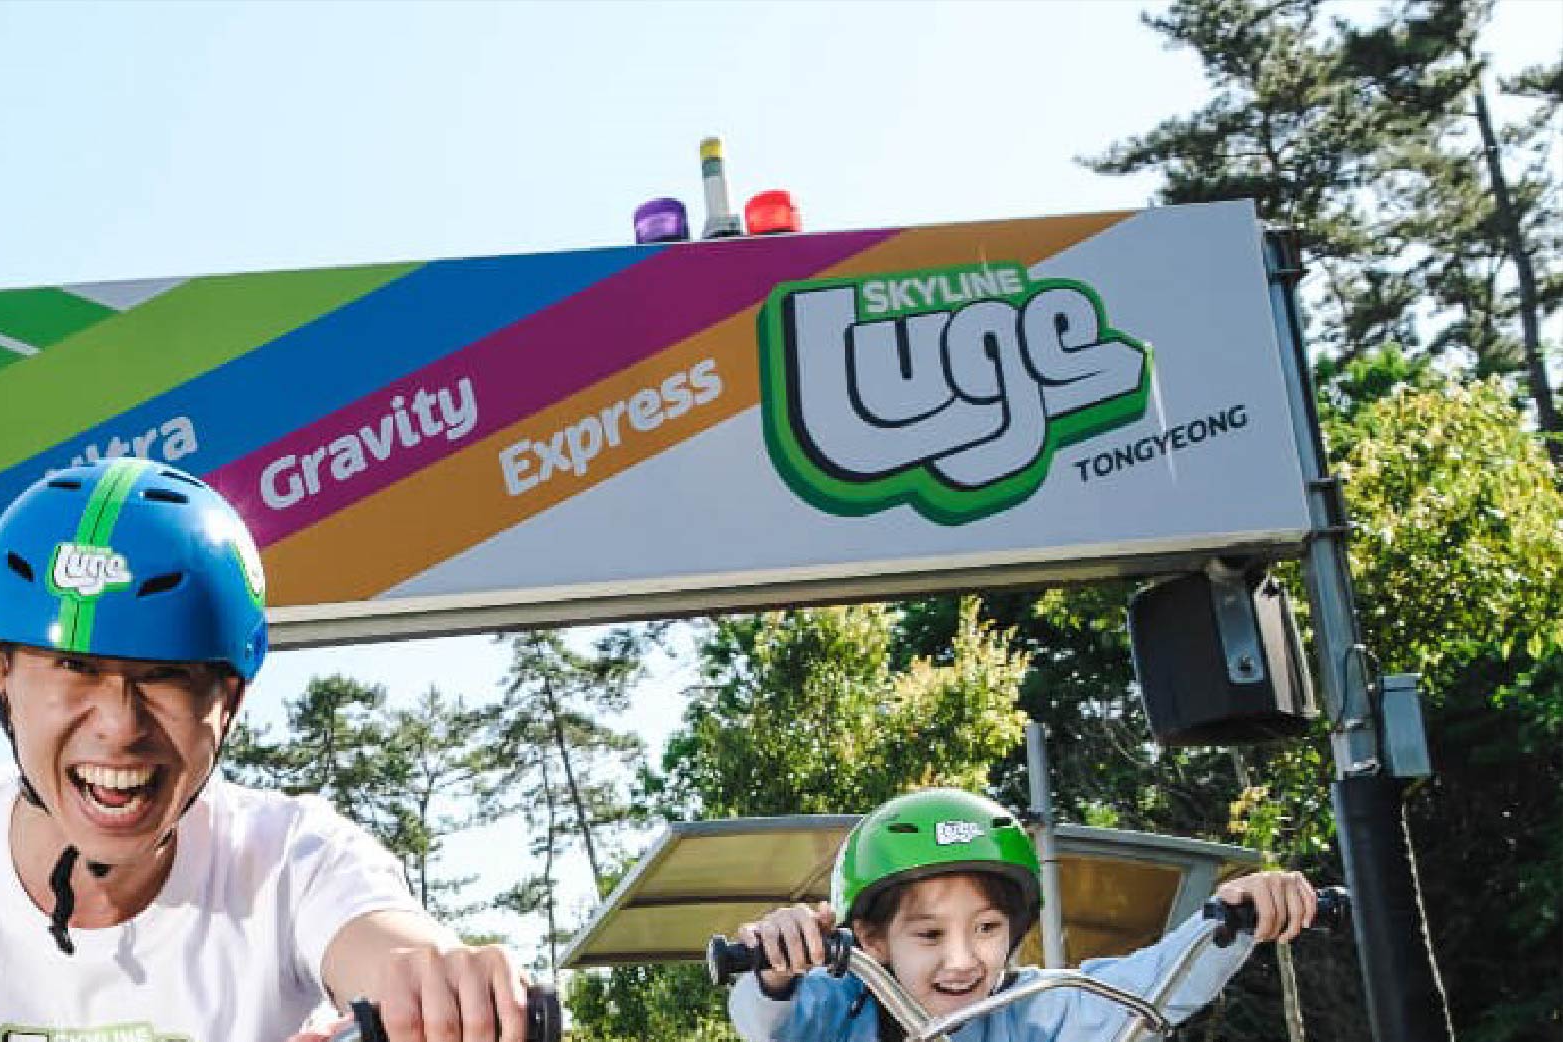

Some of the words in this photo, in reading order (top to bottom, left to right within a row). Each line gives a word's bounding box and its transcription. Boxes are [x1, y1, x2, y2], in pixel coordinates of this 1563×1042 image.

[861, 268, 1023, 314] SKYLINE
[497, 358, 723, 497] Express
[785, 285, 1147, 490] Luge
[45, 417, 198, 479] tra
[259, 376, 478, 511] Gravity
[1074, 404, 1249, 482] TONGYEONG
